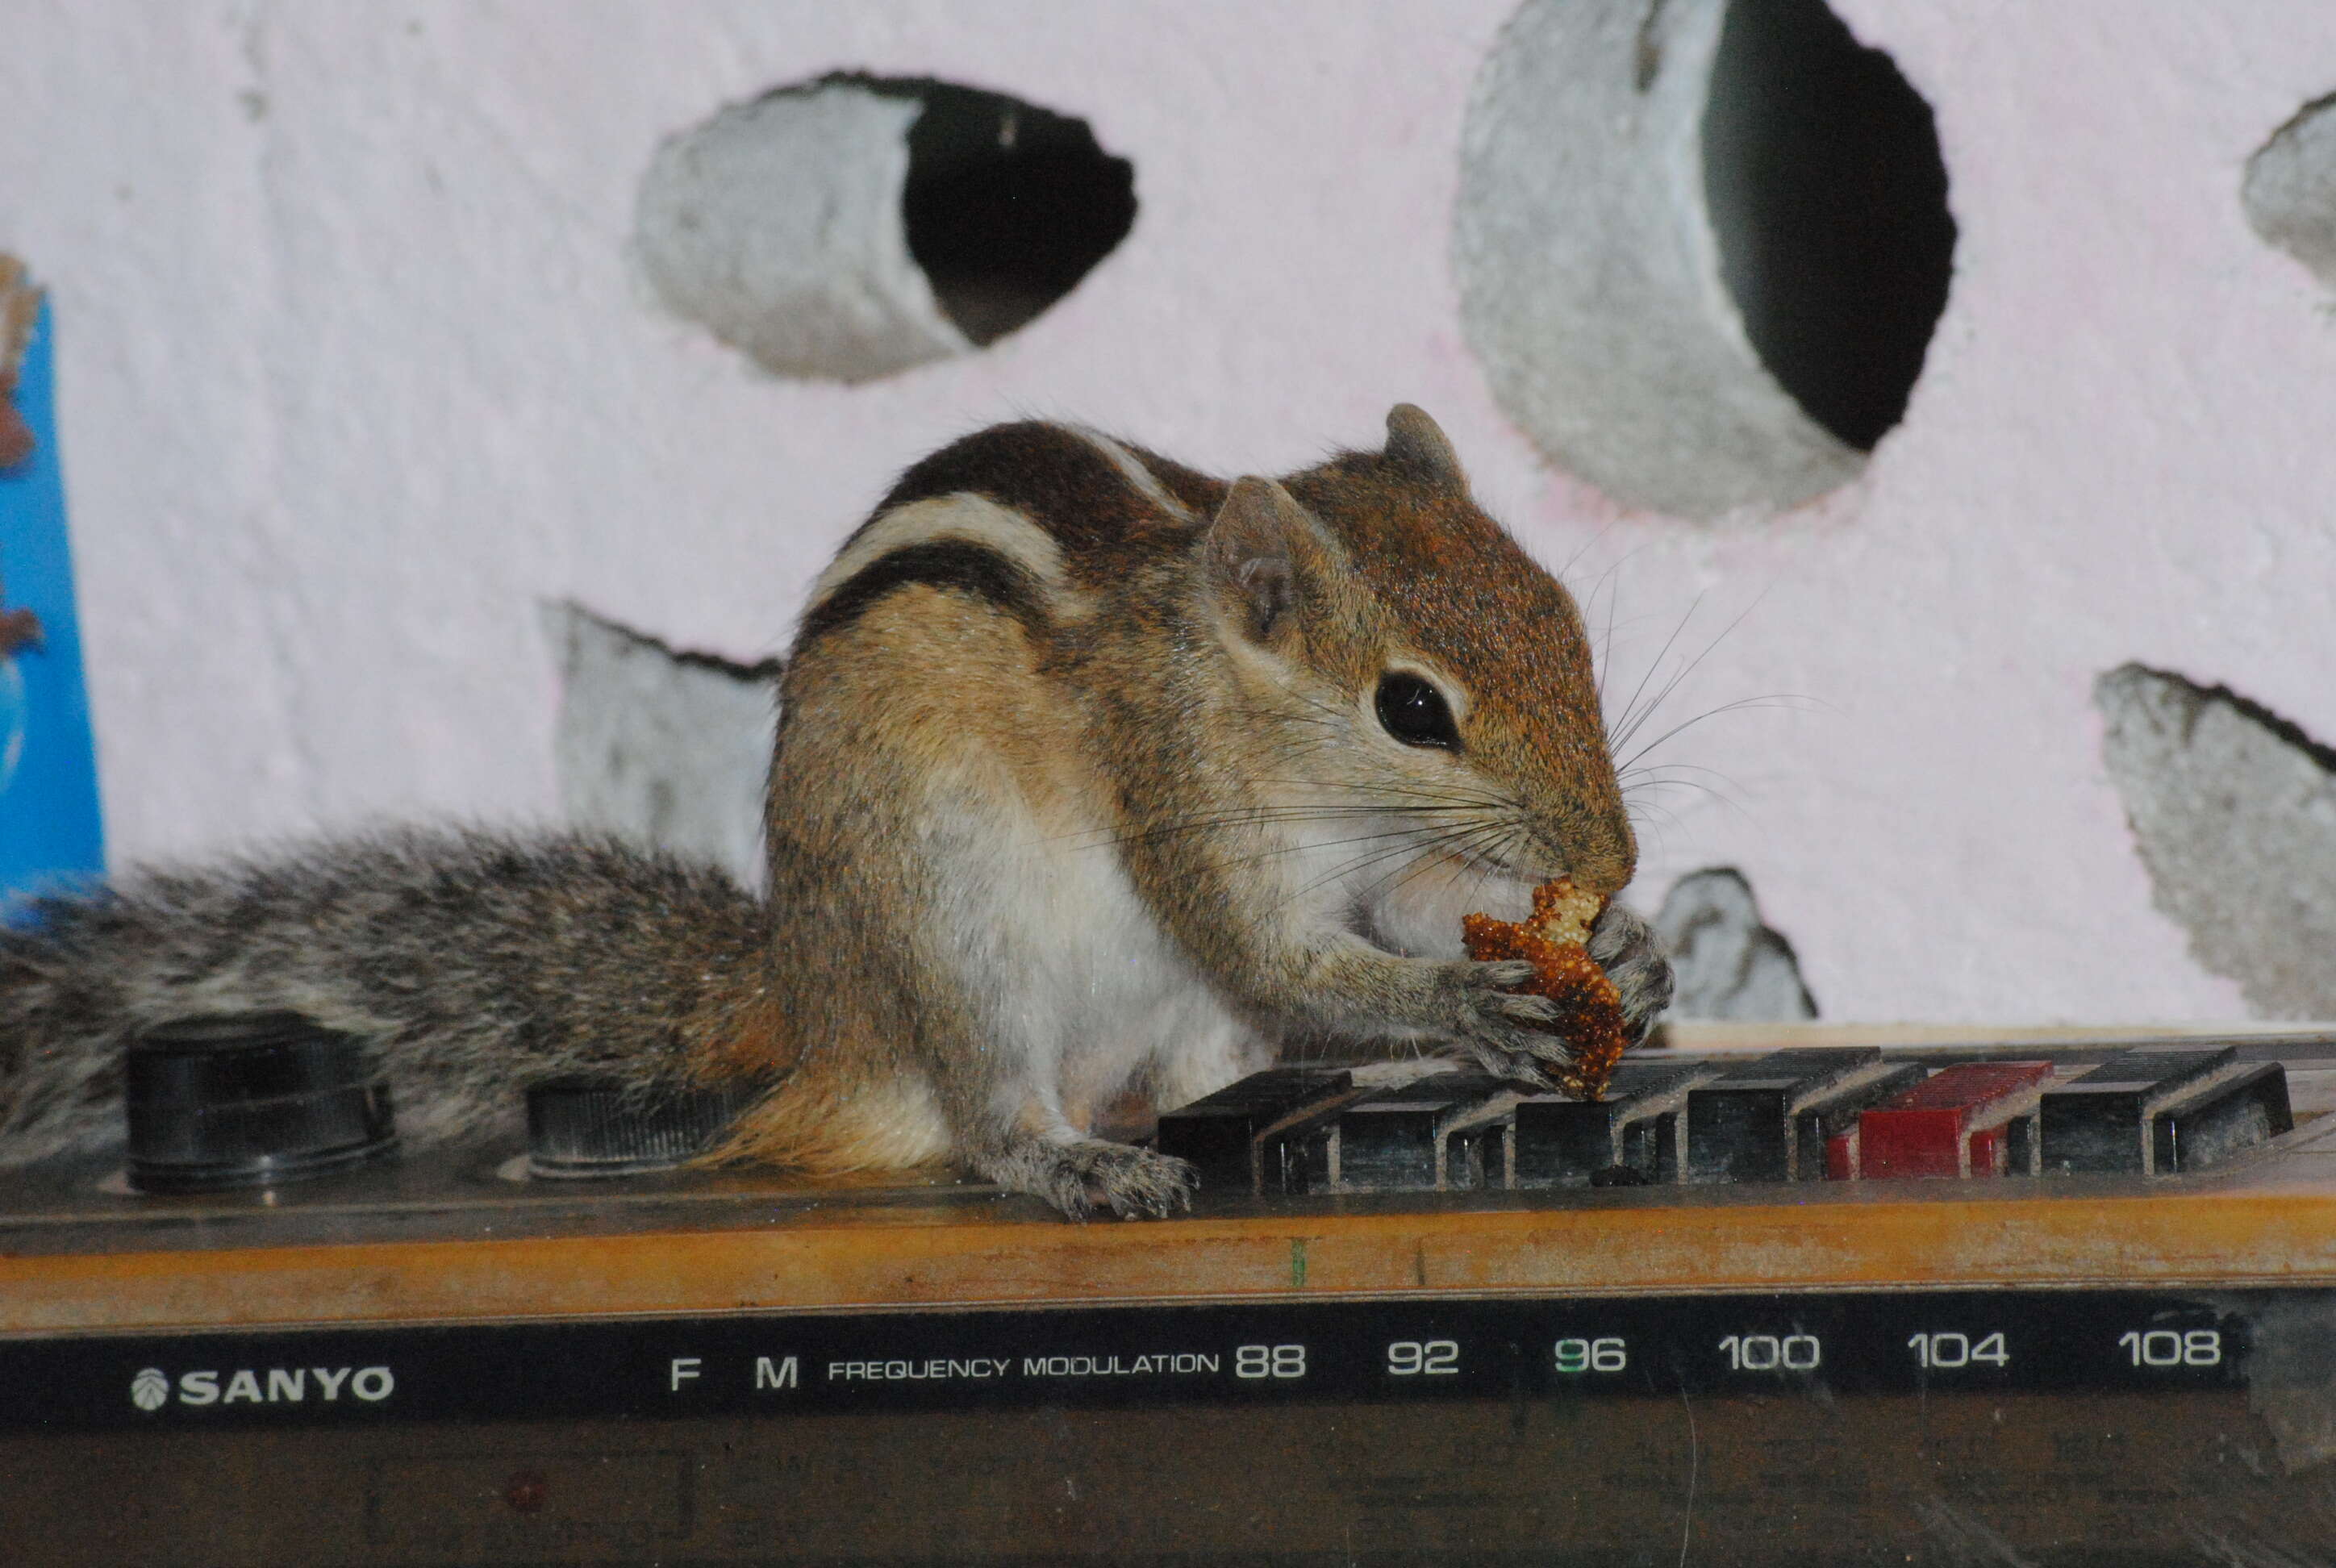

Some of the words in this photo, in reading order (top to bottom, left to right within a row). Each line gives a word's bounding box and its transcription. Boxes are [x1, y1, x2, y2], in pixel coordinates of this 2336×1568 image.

[828, 1359, 1010, 1380] FREQUENCY
[1024, 1353, 1219, 1376] MODULATION
[1236, 1345, 1306, 1378] 88
[1388, 1340, 1458, 1374] 92
[1554, 1337, 1625, 1372] 96
[1718, 1335, 1821, 1370] 100
[1908, 1332, 2009, 1368] 104
[2118, 1330, 2220, 1366] 108
[180, 1366, 394, 1404] SANYO
